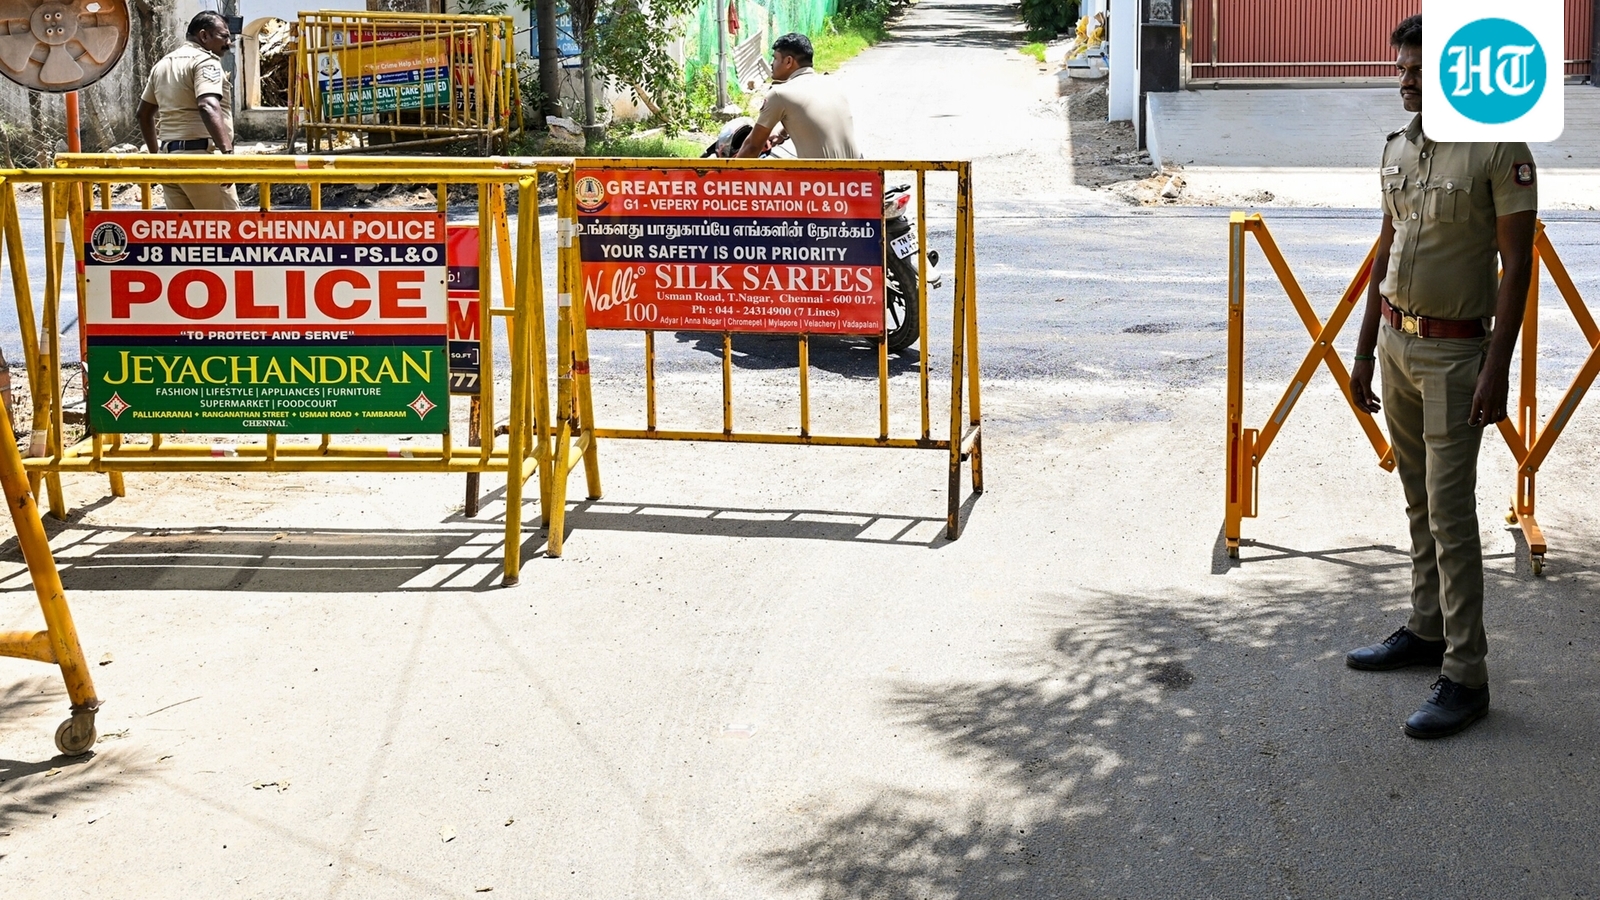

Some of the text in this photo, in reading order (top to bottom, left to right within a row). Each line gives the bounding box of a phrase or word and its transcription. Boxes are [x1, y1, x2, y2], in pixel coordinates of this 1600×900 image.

[398, 60, 412, 68] Help
[607, 180, 872, 197] GREATER CHENNAI POLICE
[624, 200, 638, 210] G1
[651, 200, 700, 210] VEPERY
[703, 200, 748, 211] POLICE
[752, 200, 802, 212] STATION
[822, 202, 832, 212] &
[131, 220, 436, 240] GREATER CHENNAI POLICE
[648, 220, 730, 239] பாதுகாப்பே
[733, 220, 804, 238] எங்களின்
[808, 221, 874, 241] நோக்கம்
[897, 237, 908, 246] TN
[136, 246, 164, 262] J8
[172, 246, 332, 262] NEELANKARAI
[354, 246, 438, 262] PS.L&O
[601, 244, 847, 261] YOUR SAFETY IS OUR PRIORITY
[900, 247, 909, 256] AJ
[655, 264, 873, 293] SILK SAREES
[110, 270, 427, 319] POLICE
[656, 291, 692, 301] Usman
[696, 292, 724, 303] Road,
[728, 292, 773, 305] T.Nagar,
[779, 293, 823, 304] Chennai
[833, 294, 852, 304] 600
[855, 295, 876, 305] 017.
[623, 302, 658, 322] 100
[692, 305, 706, 314] Ph
[715, 306, 733, 315] 044
[743, 306, 791, 316] 24314900
[807, 307, 840, 318] Lines)
[660, 316, 879, 330] Adyar Anna Nagar Chromepet Mylapore Velachery Vadapalani
[208, 331, 269, 340] PROTECT
[272, 331, 300, 340] AND
[103, 350, 432, 384] JEYACHANDRAN
[156, 388, 381, 396] FASHION LIFESTYLE APPLIANCES FURNITURE
[200, 400, 337, 408] SUPERMARKET FOODCOURT
[242, 419, 288, 427] CHENNAI.
